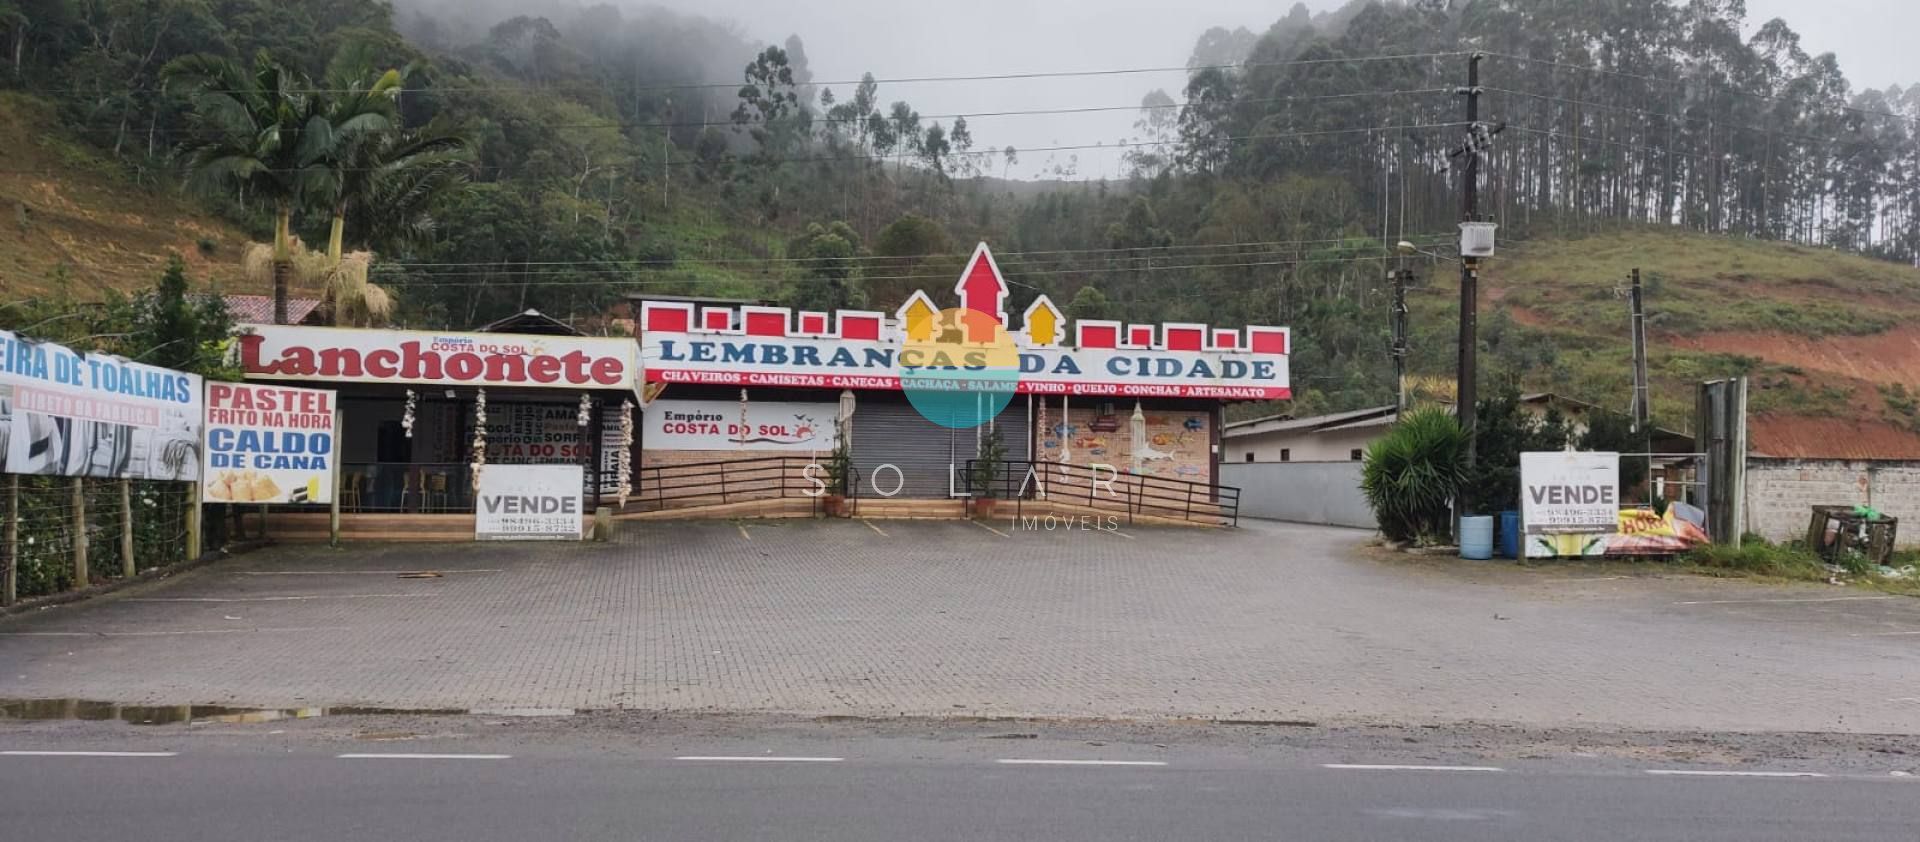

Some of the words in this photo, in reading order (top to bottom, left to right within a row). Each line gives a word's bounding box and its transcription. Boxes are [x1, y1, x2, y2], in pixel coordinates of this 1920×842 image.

[431, 343, 475, 352] COSTA
[480, 344, 498, 353] DO
[502, 345, 528, 355] SOL
[240, 334, 624, 385] Lanchonete
[659, 340, 987, 374] LEMBRANÇAS
[1019, 353, 1081, 375] DA
[1106, 356, 1276, 380] CIDADE
[55, 351, 82, 387] DE
[88, 359, 190, 403] TOALHAS
[662, 371, 741, 383] CHAVEIROS
[751, 374, 824, 386] CAMISETAS
[832, 376, 892, 388] CANECAS
[901, 378, 961, 391] CACHAÇA
[966, 381, 1018, 392] SALAME
[1026, 382, 1066, 393] VINHO
[1072, 383, 1117, 395] QUEIJO
[1123, 385, 1180, 396] CONCHAS
[1186, 386, 1265, 398] ARTESANATO
[210, 385, 332, 413] PASTEL
[209, 409, 257, 427] FRITO
[263, 411, 283, 427] NA
[289, 413, 332, 429] HORA
[664, 410, 723, 423] Empório
[662, 423, 720, 435] COSTA
[728, 424, 750, 436] DO
[759, 425, 789, 437] SOL
[208, 428, 331, 455] CALDO
[529, 445, 555, 456] DO
[210, 453, 245, 469] DE
[253, 455, 327, 470] CANA
[1529, 485, 1613, 504] VENDE
[482, 496, 577, 514] VENDE
